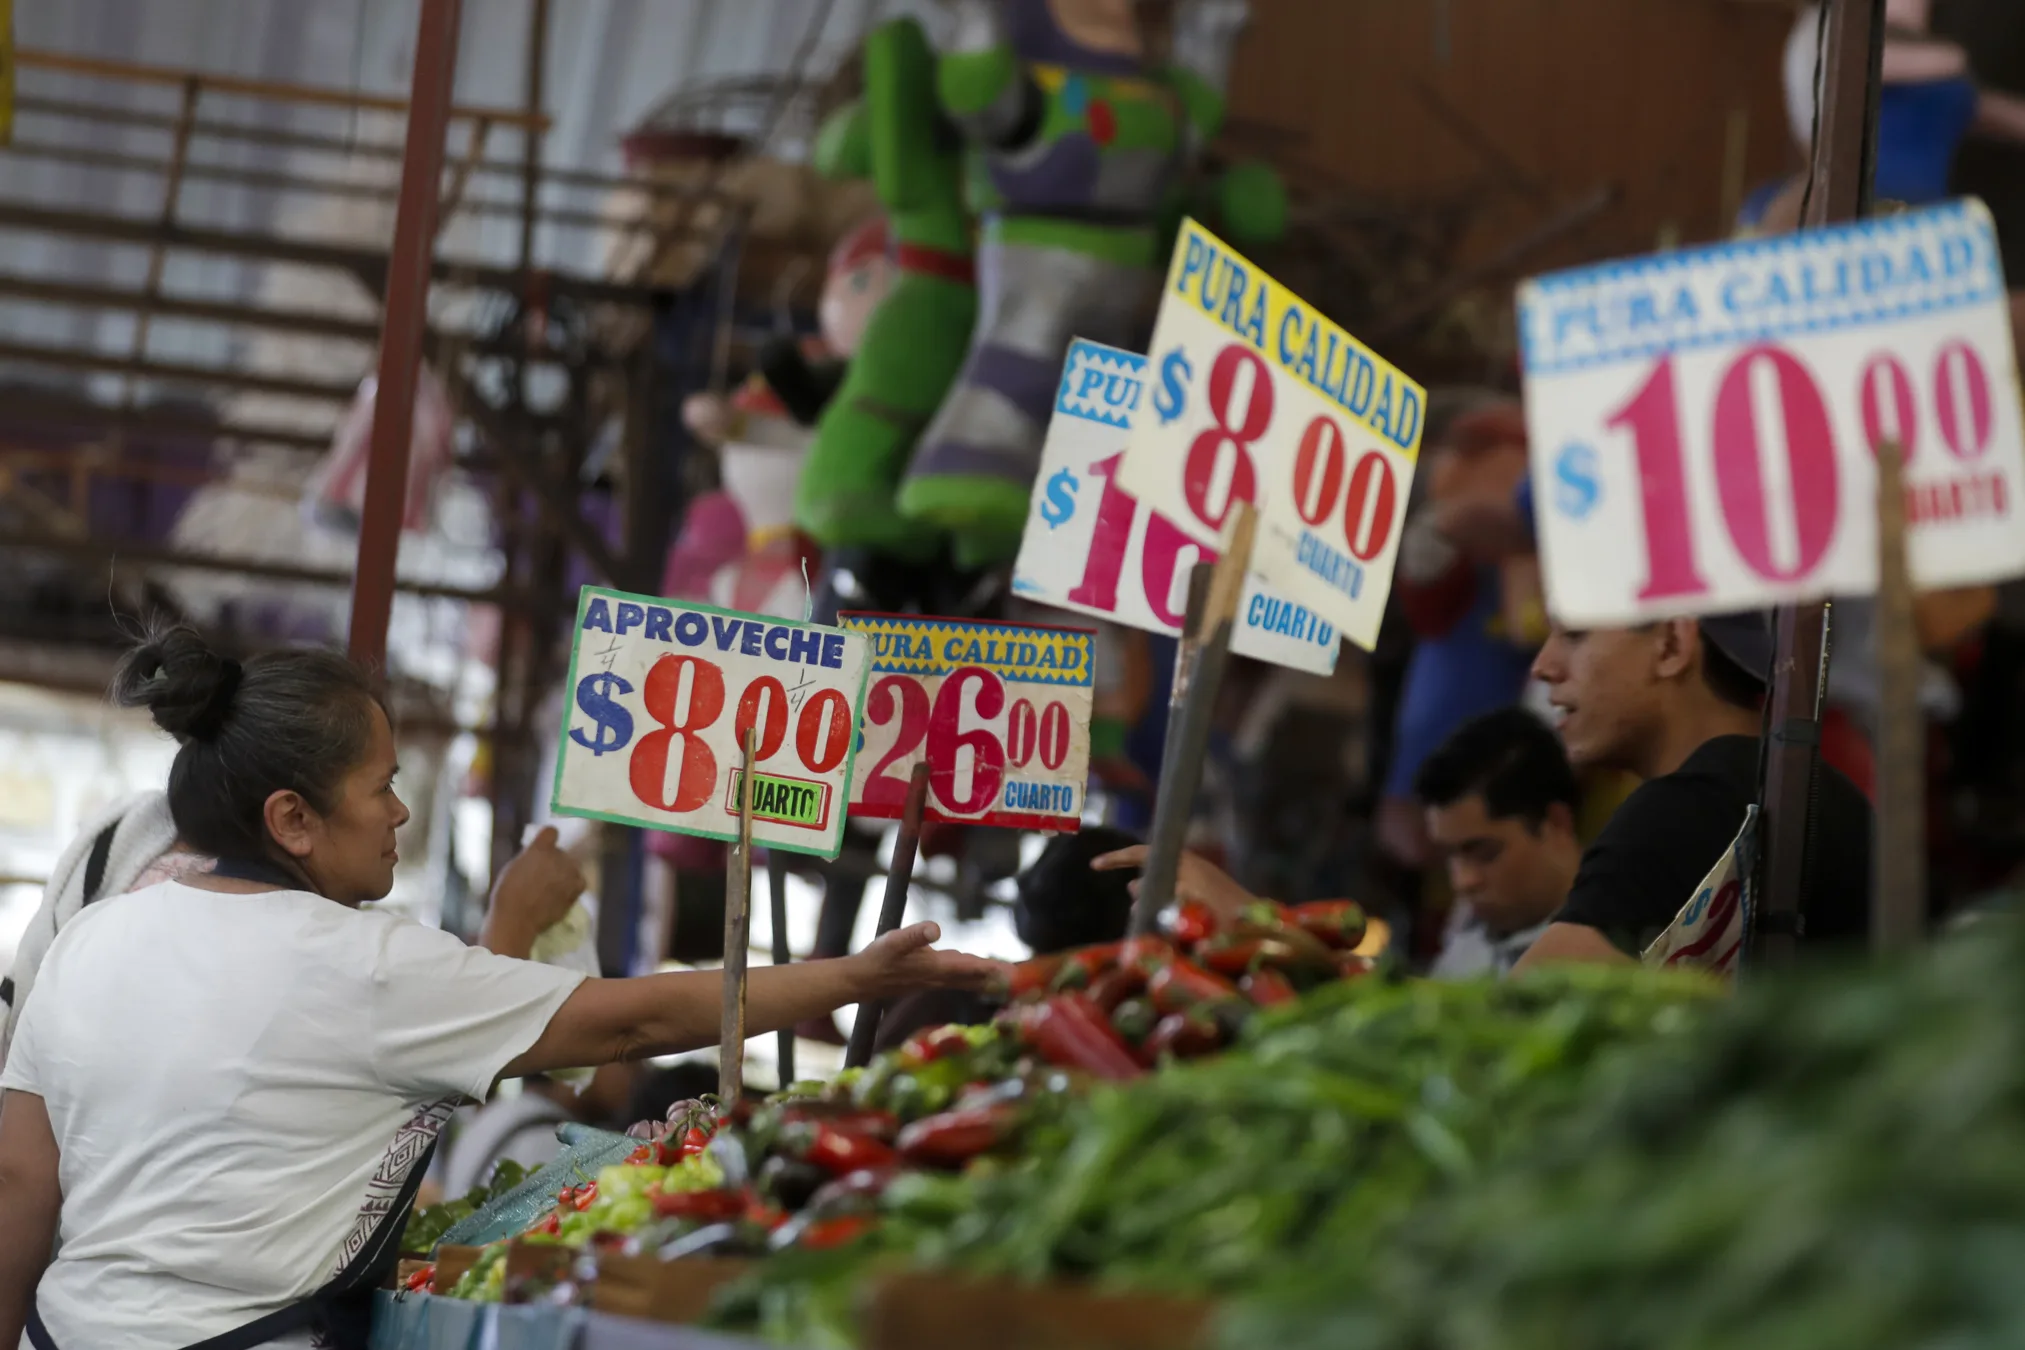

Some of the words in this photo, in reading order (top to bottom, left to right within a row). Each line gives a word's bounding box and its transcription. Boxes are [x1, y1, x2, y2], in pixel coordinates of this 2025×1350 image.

[1719, 234, 1978, 312] CALIDAD
[1179, 232, 1267, 348] PURA
[1279, 306, 1420, 449] CALIDAD
[583, 599, 845, 667] APROVECHE
[1247, 593, 1333, 647] CUARTO
[873, 632, 932, 660] URA
[943, 638, 1082, 670] CALIDAD
[1006, 783, 1073, 813] CUARTO
